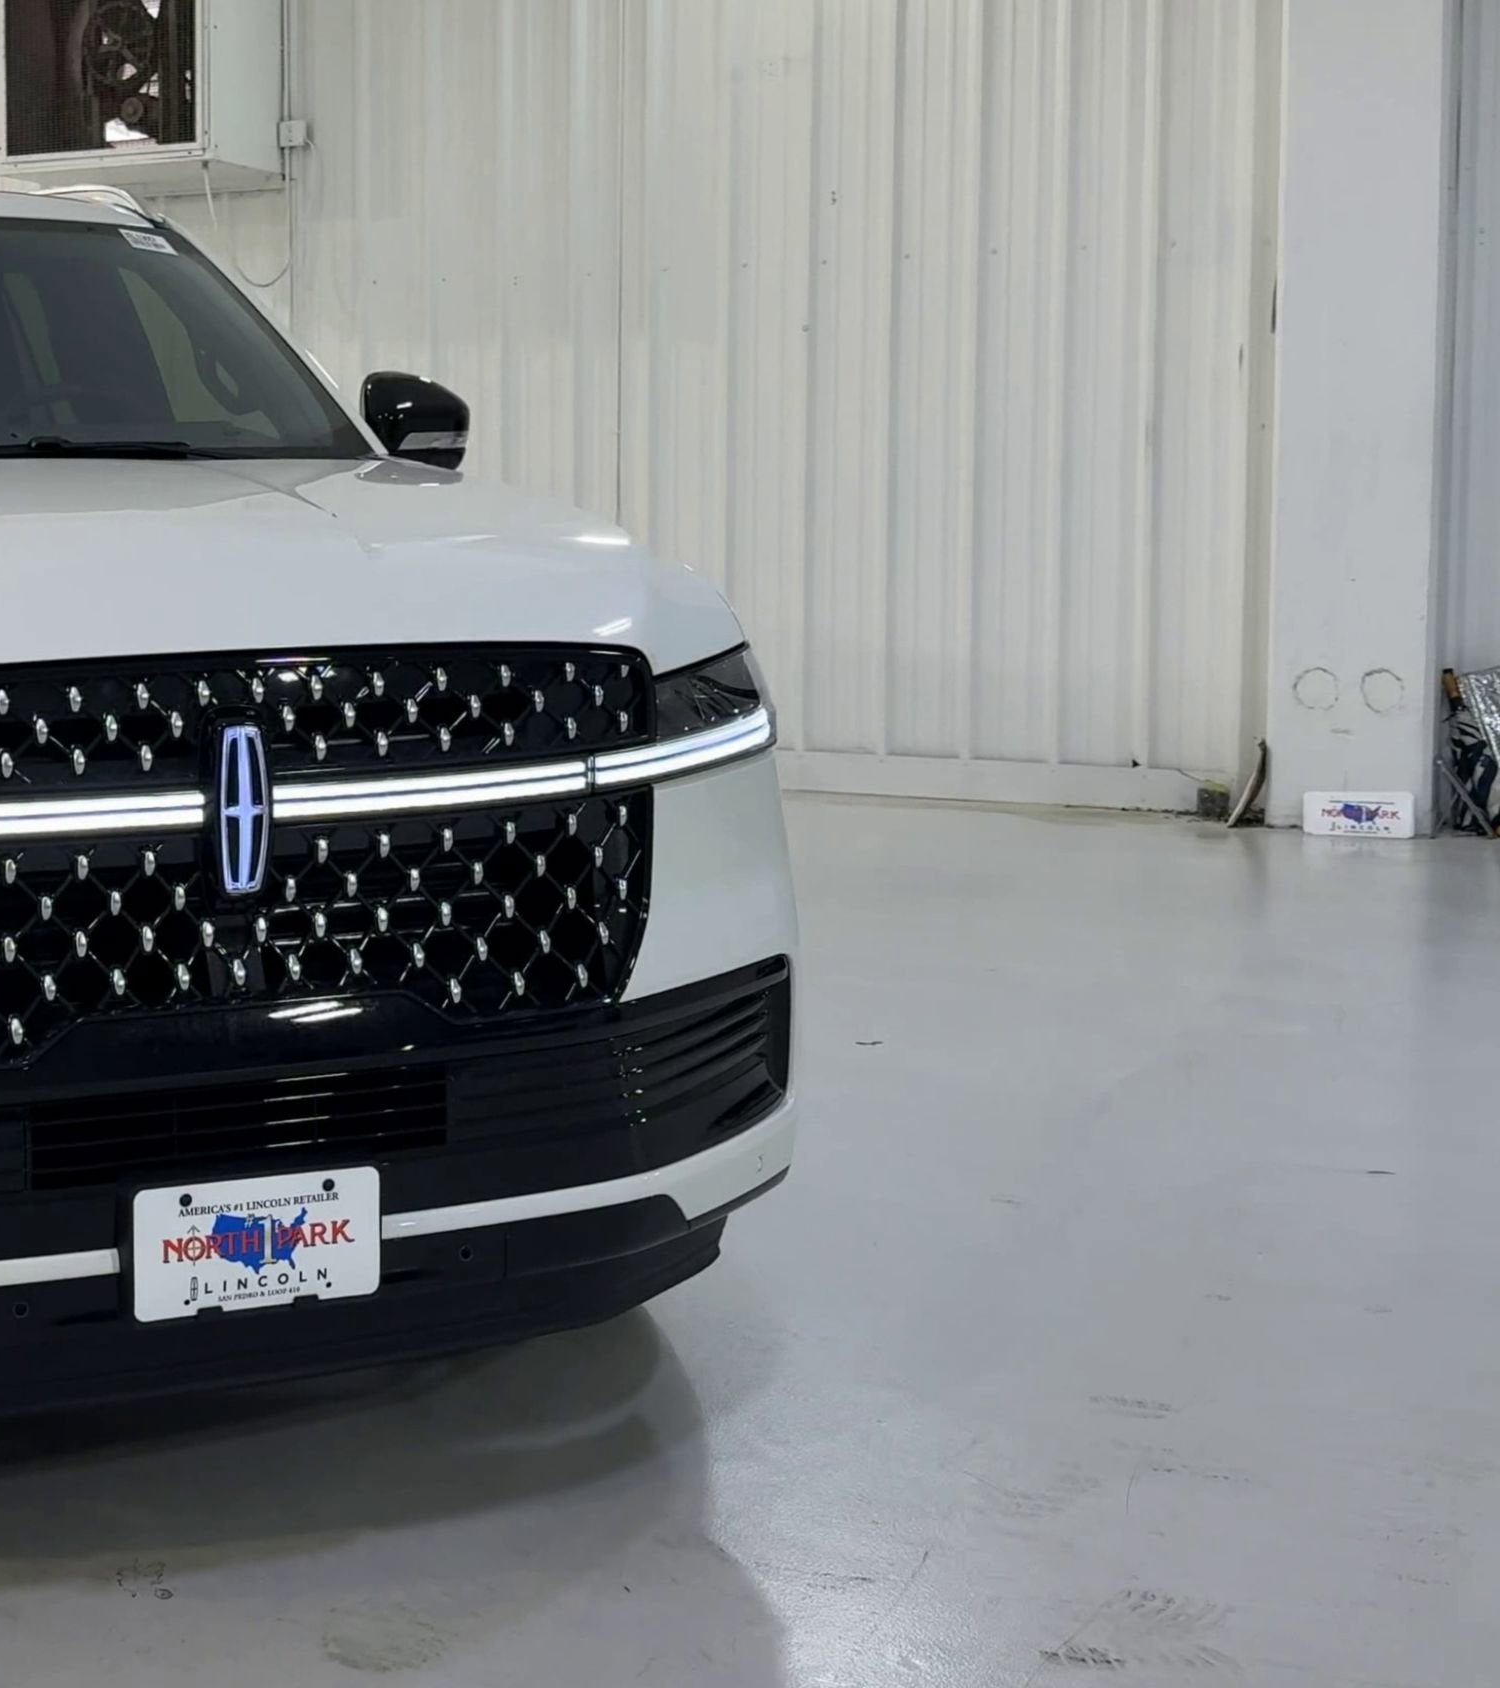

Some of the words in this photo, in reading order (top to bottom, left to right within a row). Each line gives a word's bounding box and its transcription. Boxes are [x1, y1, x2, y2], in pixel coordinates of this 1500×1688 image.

[178, 1203, 232, 1217] AMERICA'S
[233, 1203, 244, 1211] #1
[246, 1197, 291, 1210] LINCOLN
[293, 1192, 339, 1205] RETAILER
[162, 1229, 260, 1264] NORTH
[276, 1219, 355, 1249] PARK
[204, 1268, 328, 1294] LINCOLN
[218, 1294, 232, 1302] SAN
[233, 1291, 258, 1301] PEDRO
[268, 1288, 287, 1296] LOOP
